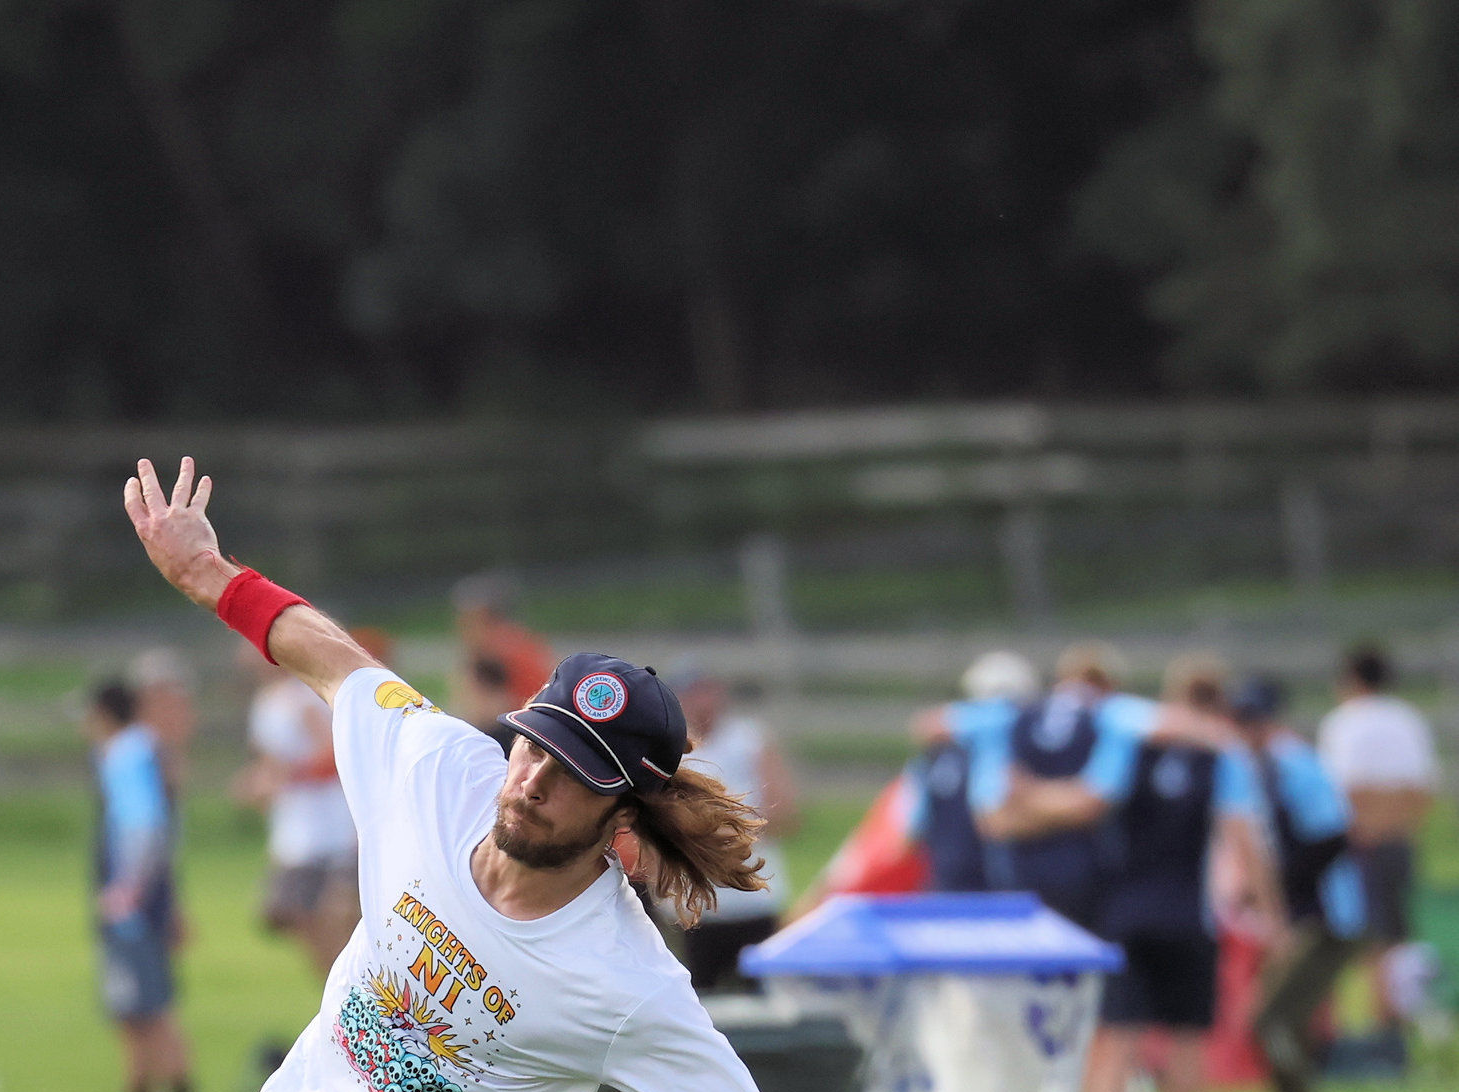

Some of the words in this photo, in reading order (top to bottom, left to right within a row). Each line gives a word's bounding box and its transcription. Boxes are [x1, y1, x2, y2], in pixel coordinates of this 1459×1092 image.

[585, 677, 612, 687] ANDREWS
[611, 681, 621, 693] OLD
[578, 697, 608, 717] SCOTLAND
[610, 692, 623, 714] COURSE
[392, 892, 487, 991] KNIGHTS
[483, 985, 516, 1025] OF
[408, 941, 466, 1014] NI
